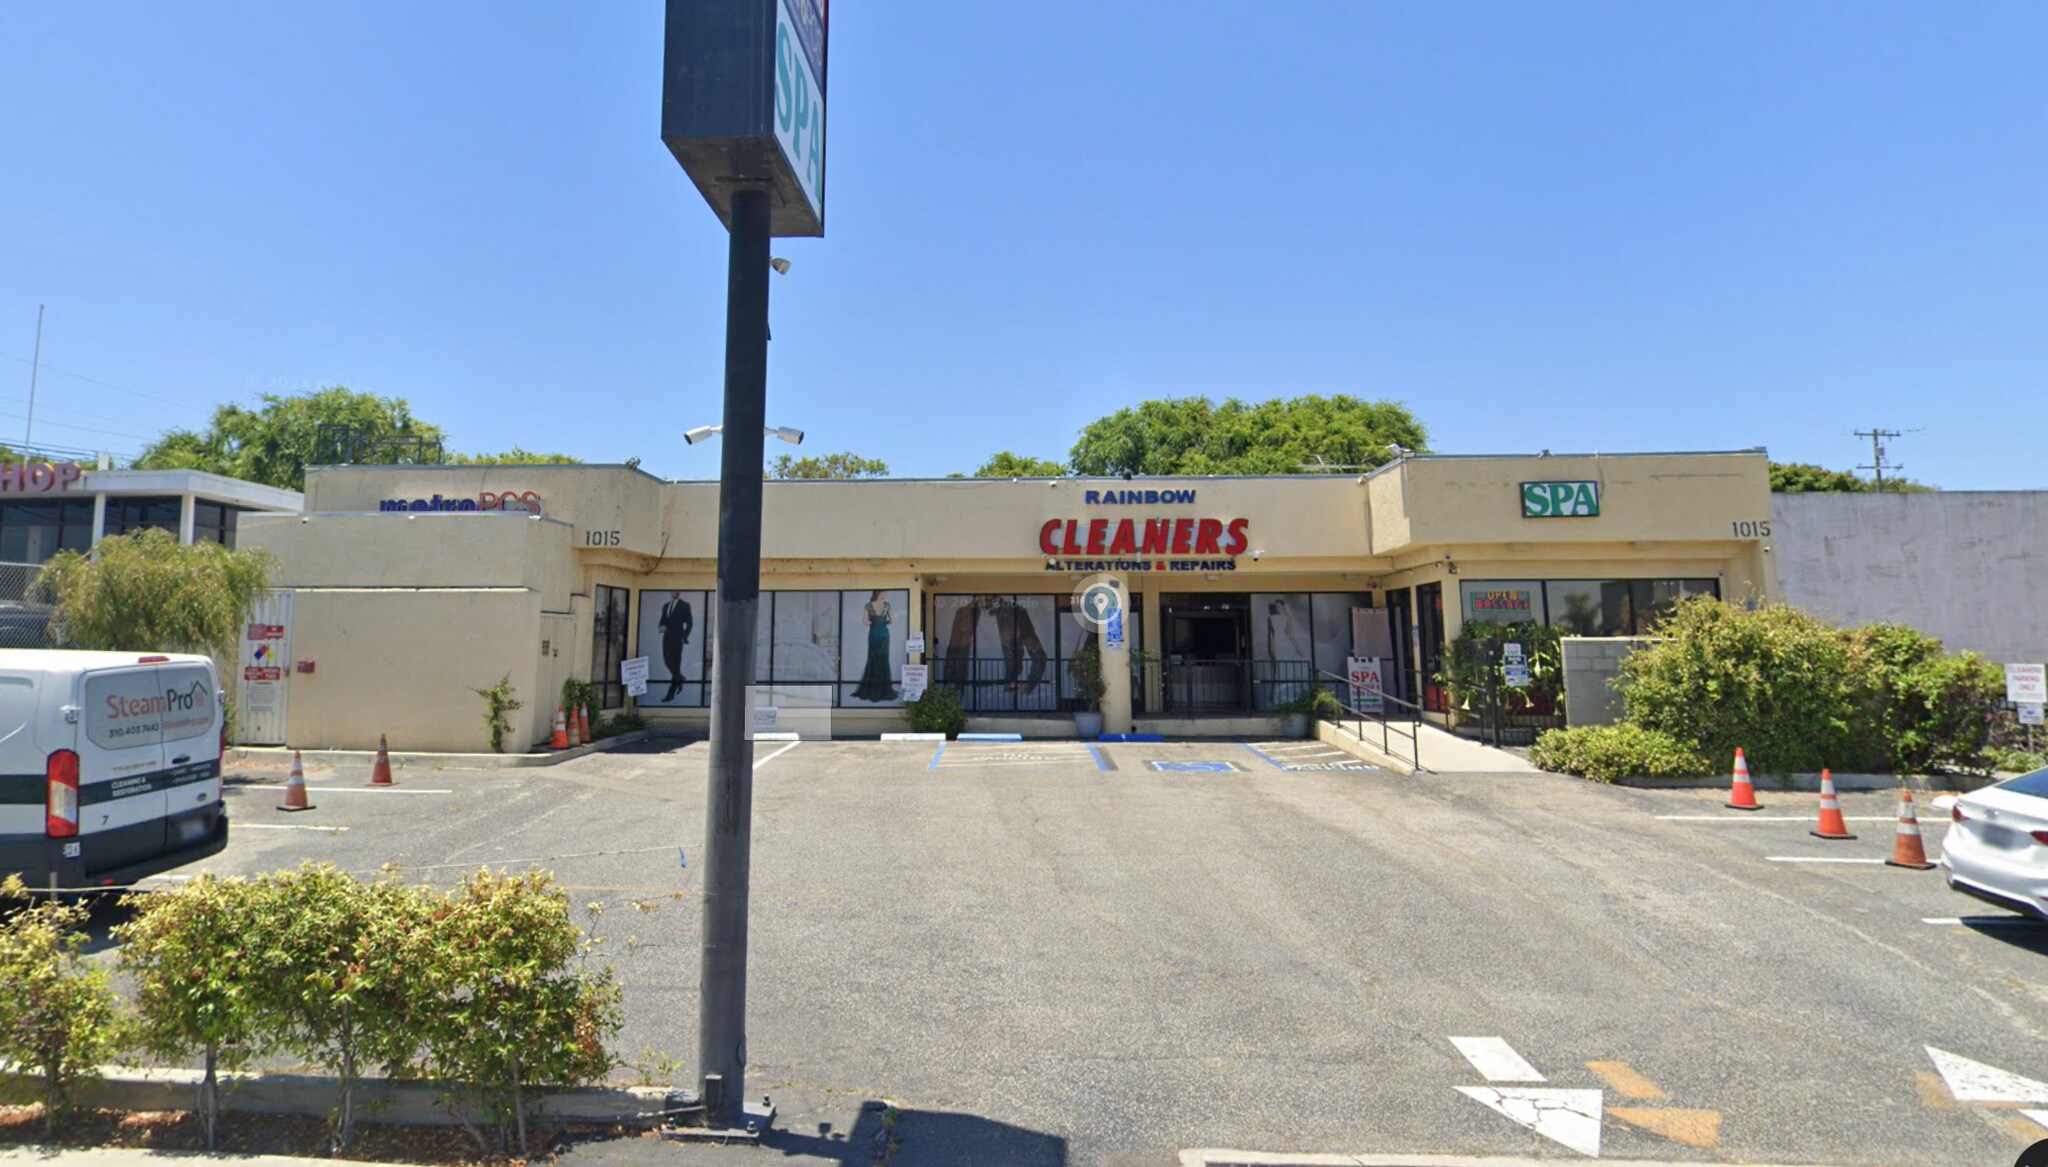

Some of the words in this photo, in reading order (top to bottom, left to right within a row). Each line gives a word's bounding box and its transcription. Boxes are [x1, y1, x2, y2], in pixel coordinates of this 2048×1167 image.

[775, 22, 821, 204] SPA
[1085, 490, 1196, 504] RAINBOW
[1525, 483, 1596, 516] SPA
[1039, 517, 1250, 556] CLEANERS
[1732, 520, 1771, 538] 1015
[585, 530, 620, 546] 1015
[1045, 559, 1152, 571] ALTERATIONS
[1155, 560, 1166, 571] &
[1170, 558, 1237, 571] REPAIRS
[1351, 671, 1380, 683] SPA
[106, 688, 194, 720] SteamPro
[102, 815, 109, 825] 7
